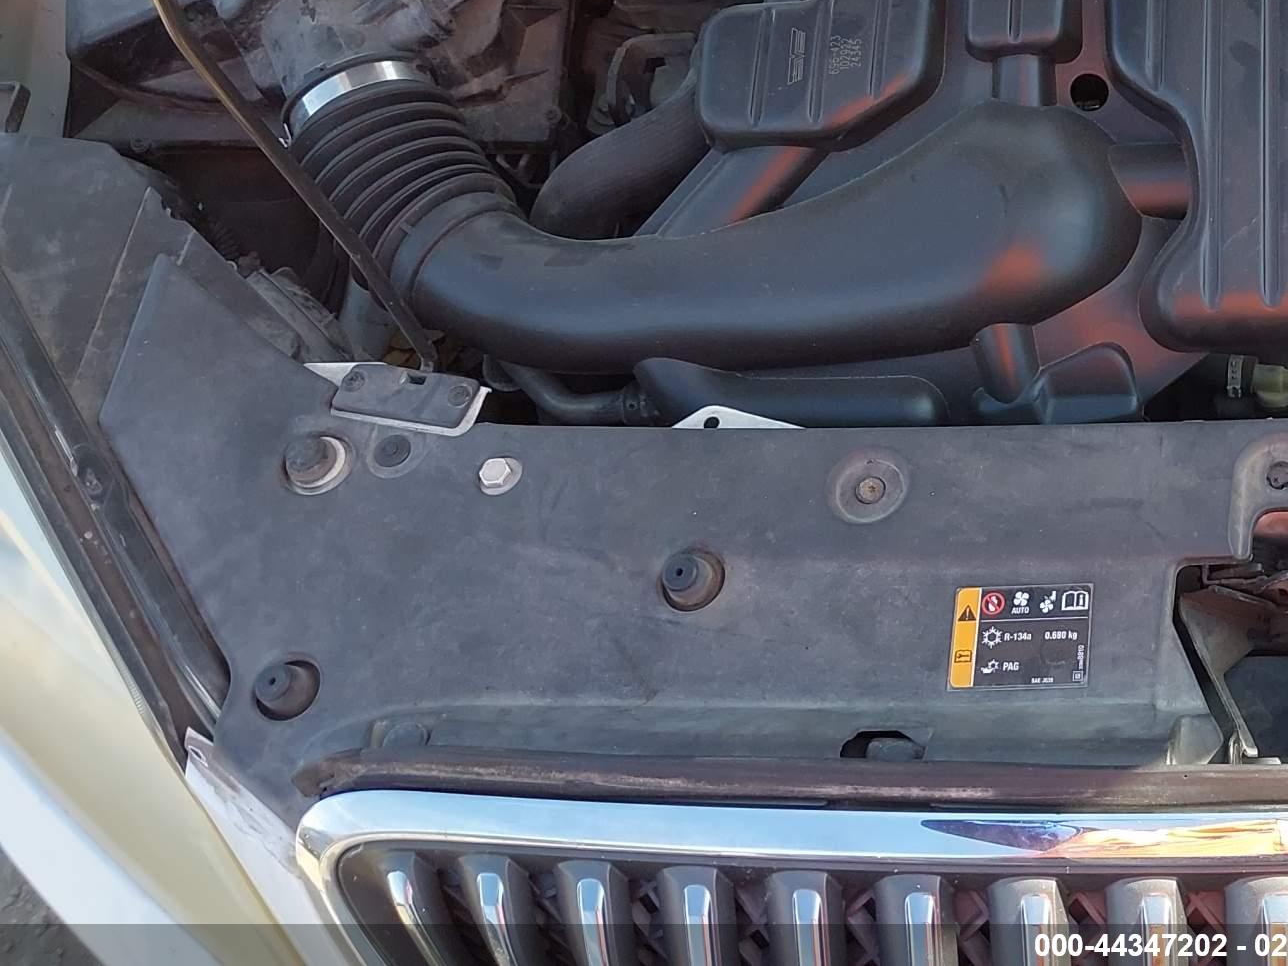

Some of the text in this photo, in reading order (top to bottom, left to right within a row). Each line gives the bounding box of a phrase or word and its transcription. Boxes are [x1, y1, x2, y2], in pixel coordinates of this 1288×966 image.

[1011, 606, 1030, 615] AUTO
[1004, 632, 1032, 641] R-134a
[1068, 629, 1078, 640] kg
[1002, 661, 1020, 671] PAG
